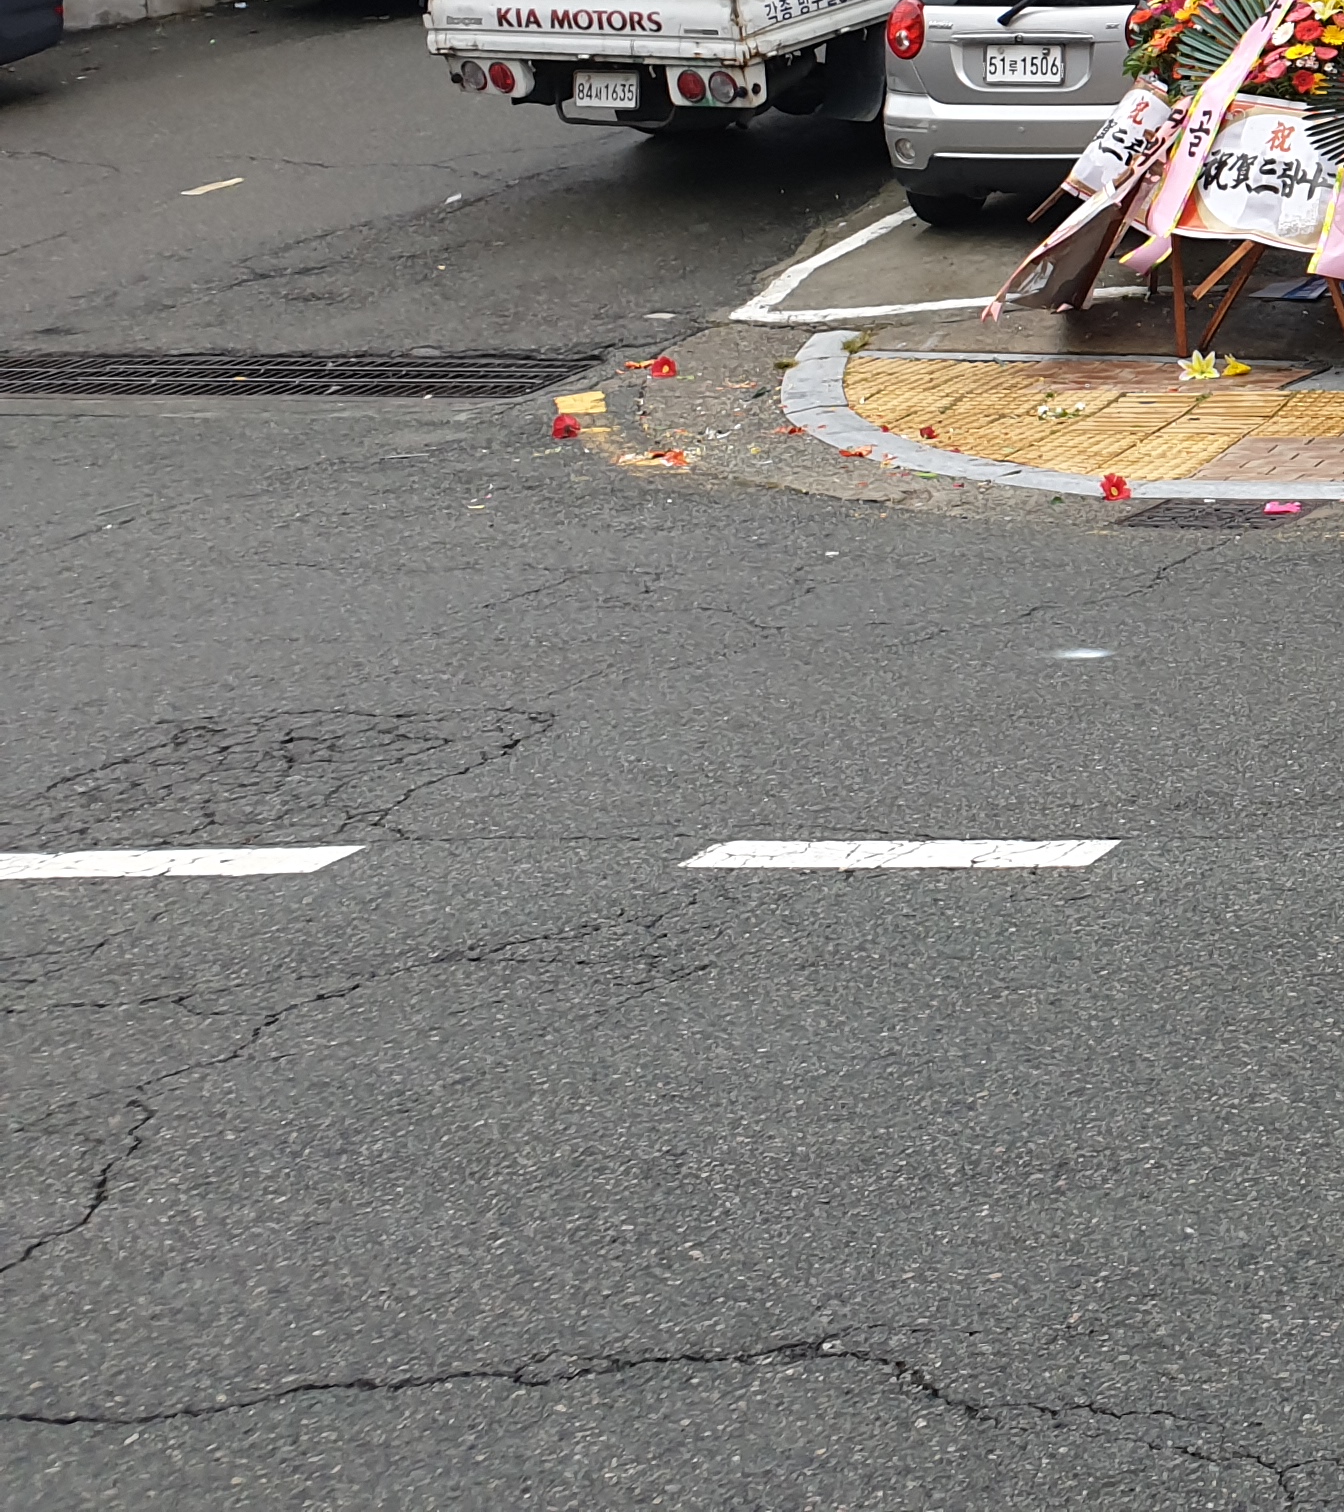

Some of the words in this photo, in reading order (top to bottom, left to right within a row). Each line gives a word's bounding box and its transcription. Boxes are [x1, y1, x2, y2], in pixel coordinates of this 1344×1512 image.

[495, 7, 542, 29] KIA
[550, 8, 663, 33] MOTORS
[987, 53, 1060, 77] 51루1506
[1265, 120, 1296, 153] 祝
